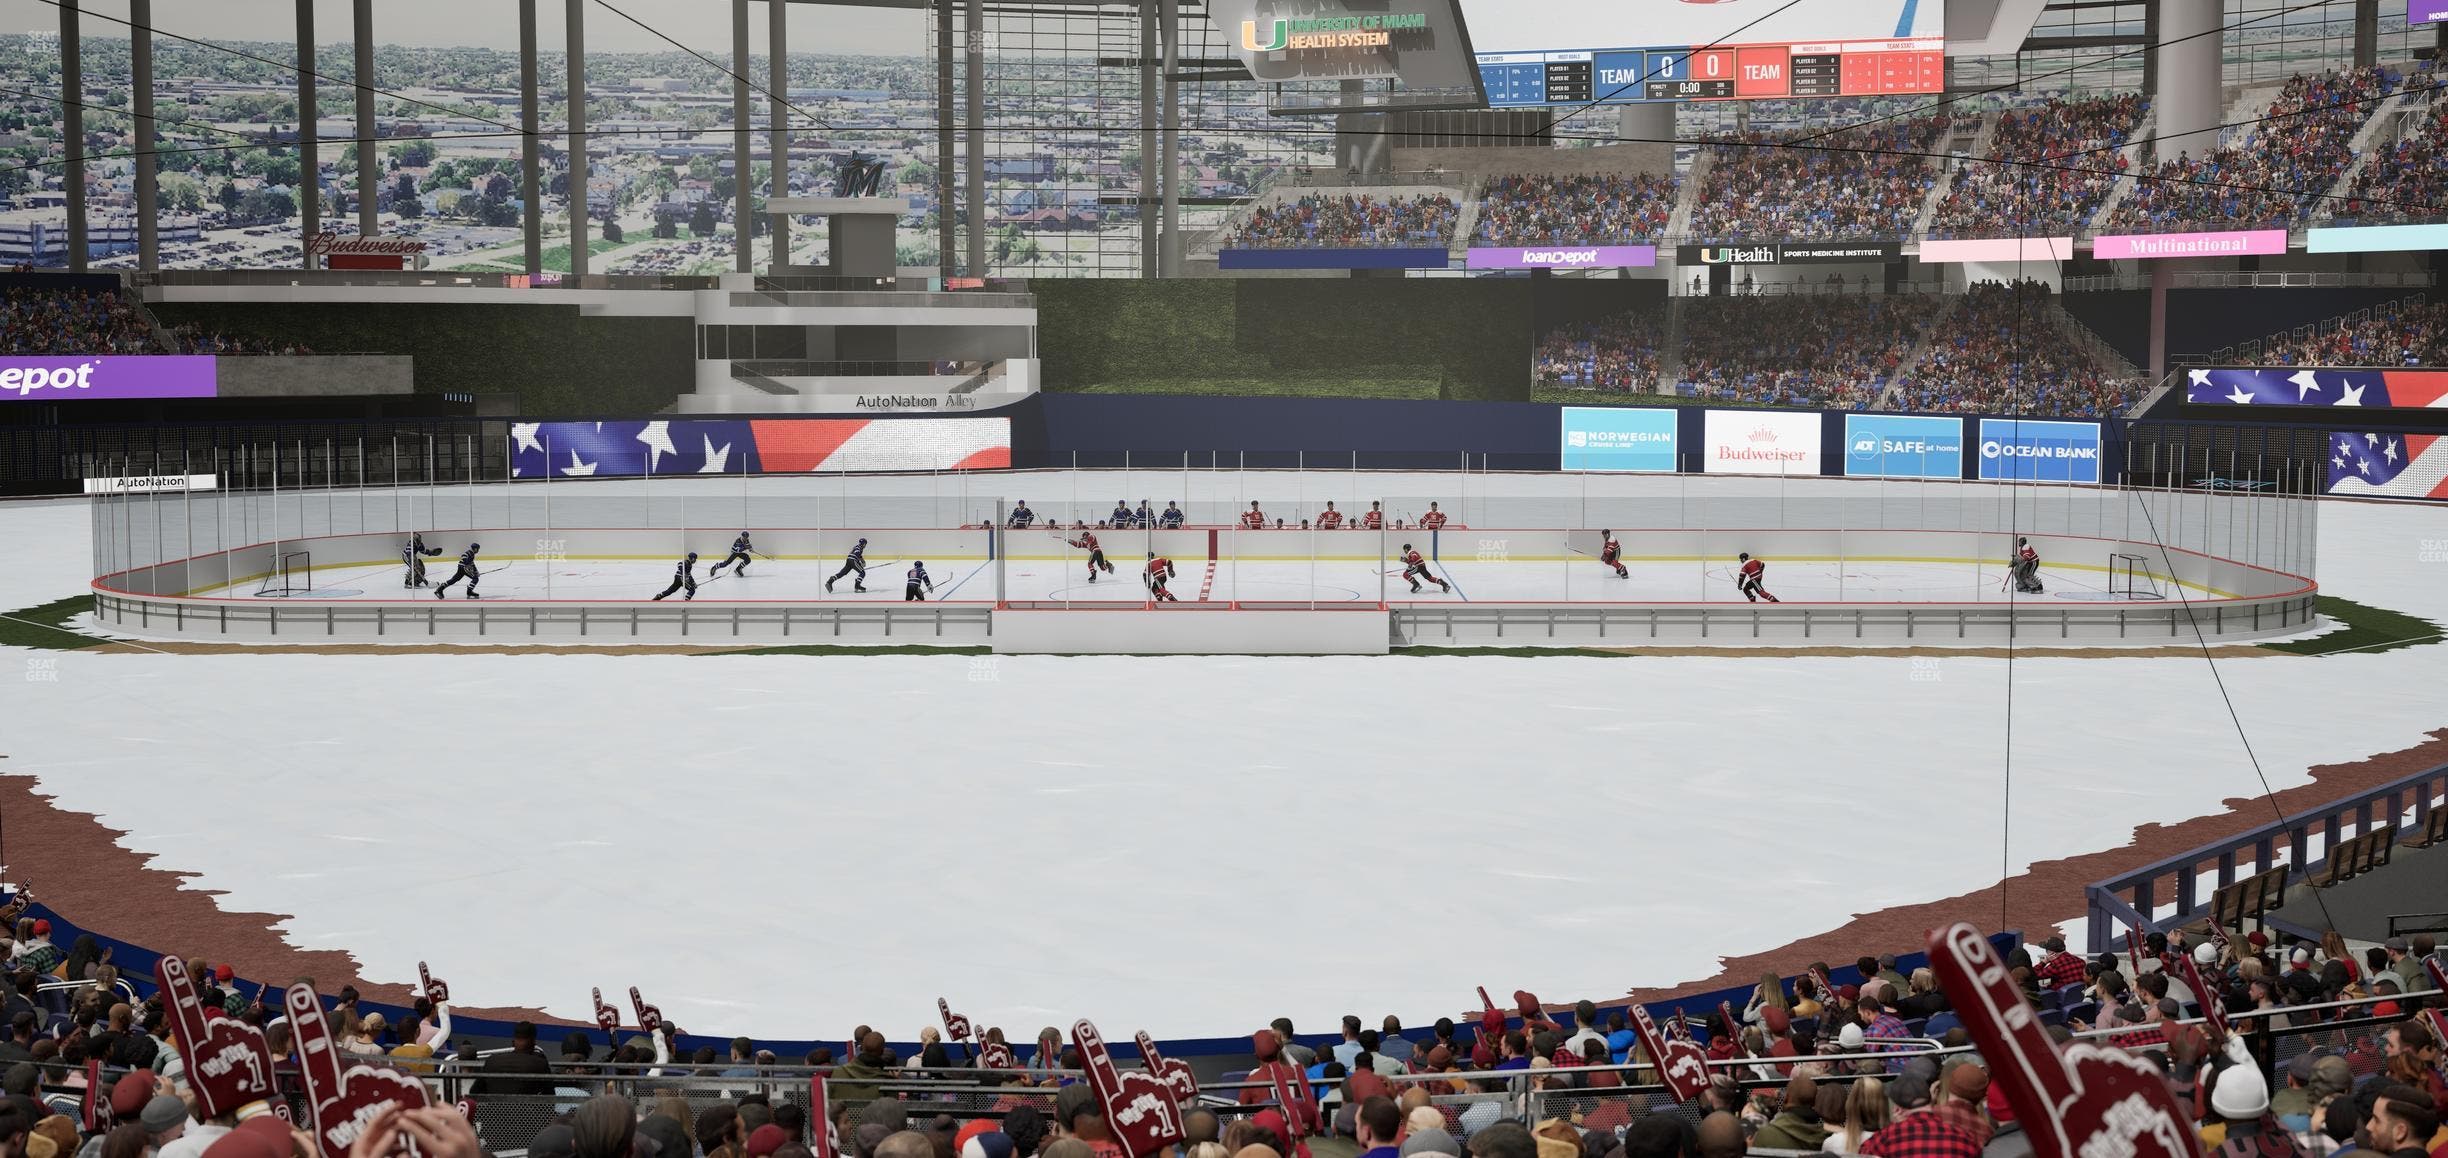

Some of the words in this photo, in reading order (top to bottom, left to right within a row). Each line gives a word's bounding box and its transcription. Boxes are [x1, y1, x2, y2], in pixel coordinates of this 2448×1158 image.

[1289, 16, 1361, 33] UNIVERSITY
[1363, 15, 1381, 30] OF
[1383, 13, 1425, 28] MIAMI
[1241, 19, 1287, 52] U
[1289, 33, 1336, 49] HEALTH
[1338, 31, 1388, 47] SYSTEM
[1661, 56, 1673, 78] 0
[1706, 54, 1718, 76] 0
[1744, 64, 1780, 80] TEAM
[1600, 69, 1635, 84] TEAM
[1680, 82, 1700, 93] 0:00
[304, 231, 427, 255] Budweiser
[2129, 236, 2248, 254] Multinational
[1522, 248, 1598, 266] loanDepot
[856, 394, 938, 408] AutoNation
[945, 394, 977, 409] Alley
[1588, 431, 1671, 442] NORWEGIAN
[1854, 440, 1876, 451] ADT
[1883, 440, 1925, 454] SAFE
[1926, 444, 1934, 452] at
[1936, 444, 1959, 452] home
[2003, 444, 2052, 458] OCEAN
[2055, 445, 2097, 459] BANK
[1718, 446, 1806, 461] Budweiser
[117, 476, 185, 488] AutoNation
